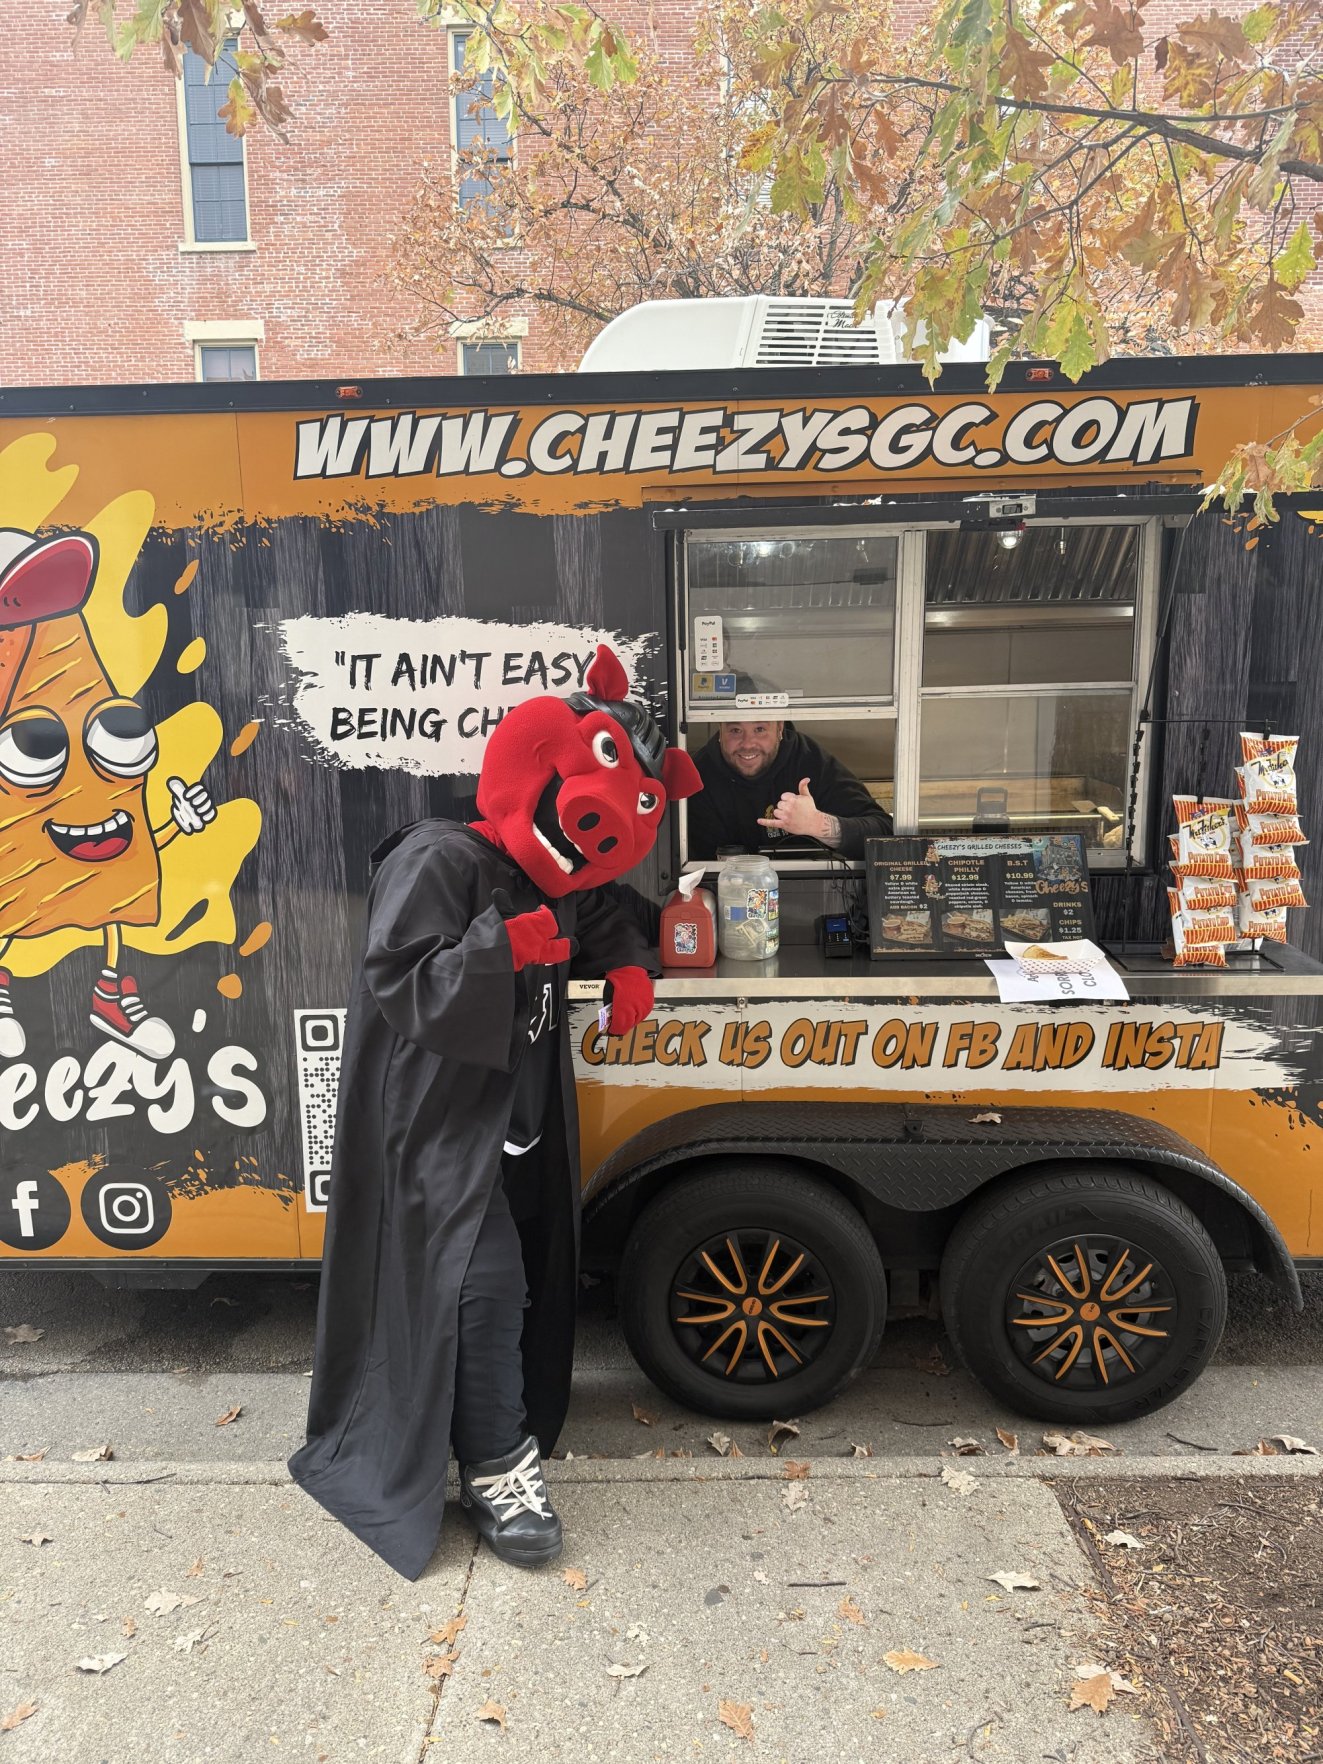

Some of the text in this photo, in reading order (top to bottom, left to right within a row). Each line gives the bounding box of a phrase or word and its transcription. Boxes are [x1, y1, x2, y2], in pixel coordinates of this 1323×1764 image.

[294, 396, 1200, 480] WWW.CHEEZYSGC.COM
[335, 650, 596, 691] "IT AIN'T EASY
[330, 706, 516, 743] BEING CH
[1036, 878, 1088, 894] Cheezy's
[581, 1017, 1225, 1072] CHECK US OUT ON FB AND INSTA
